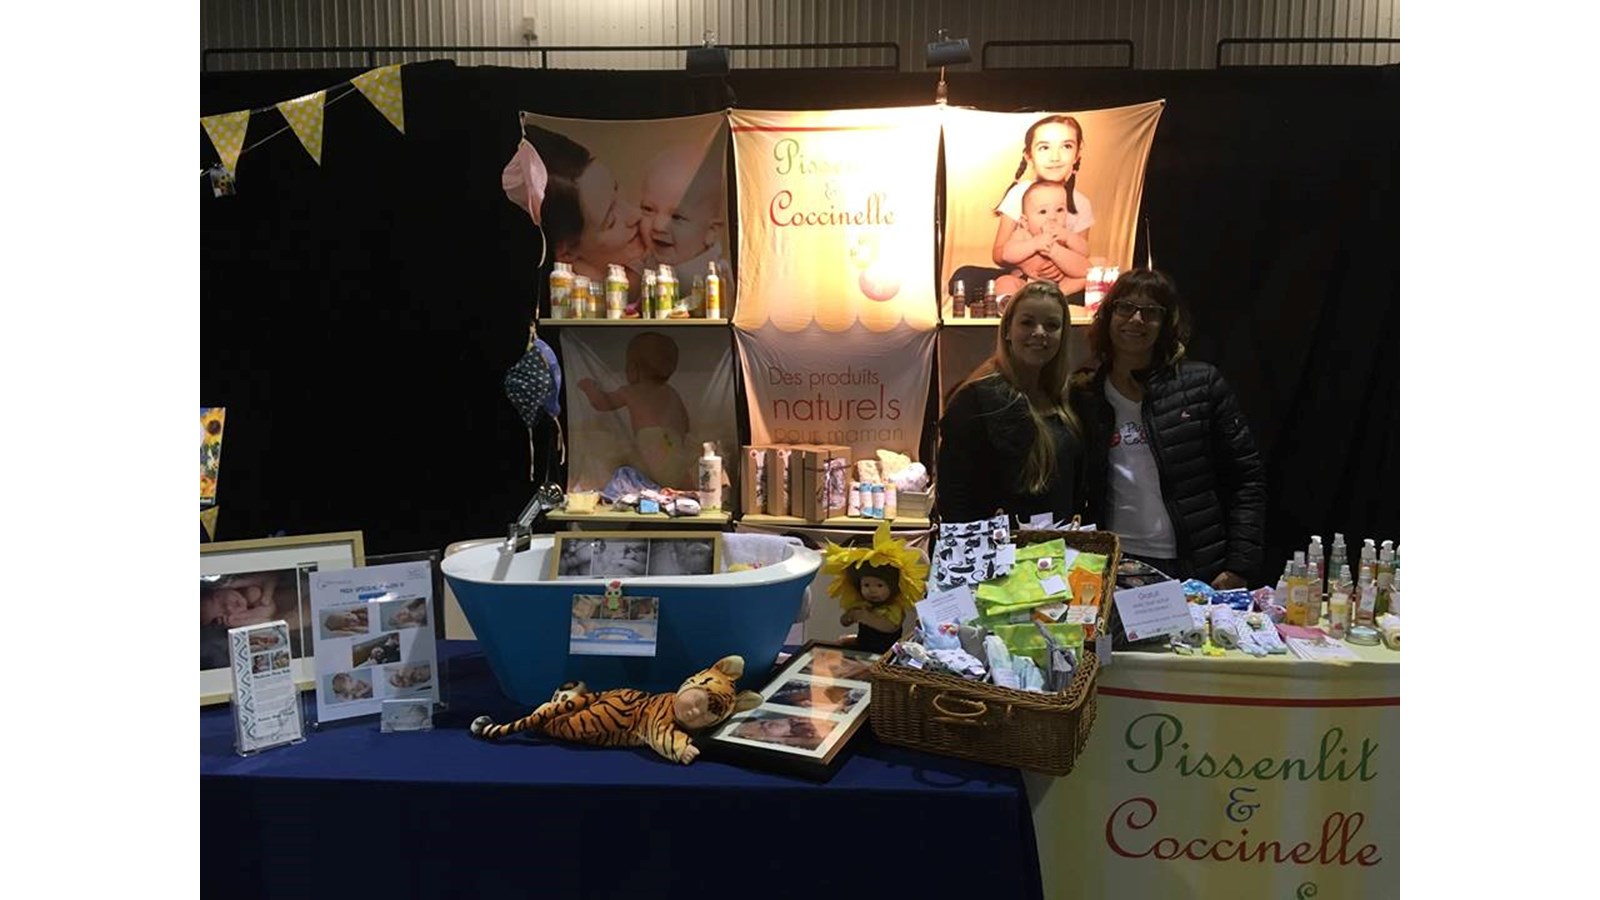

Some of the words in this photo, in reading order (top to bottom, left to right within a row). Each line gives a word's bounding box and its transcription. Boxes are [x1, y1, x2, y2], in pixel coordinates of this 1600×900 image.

[769, 190, 895, 227] Coccinelle
[768, 366, 802, 386] Des
[809, 365, 880, 388] produits
[773, 384, 901, 421] naturels
[827, 427, 904, 443] maman
[1125, 713, 1378, 782] Pissenlit
[1225, 787, 1261, 823] &
[1105, 797, 1382, 867] Coccinelle
